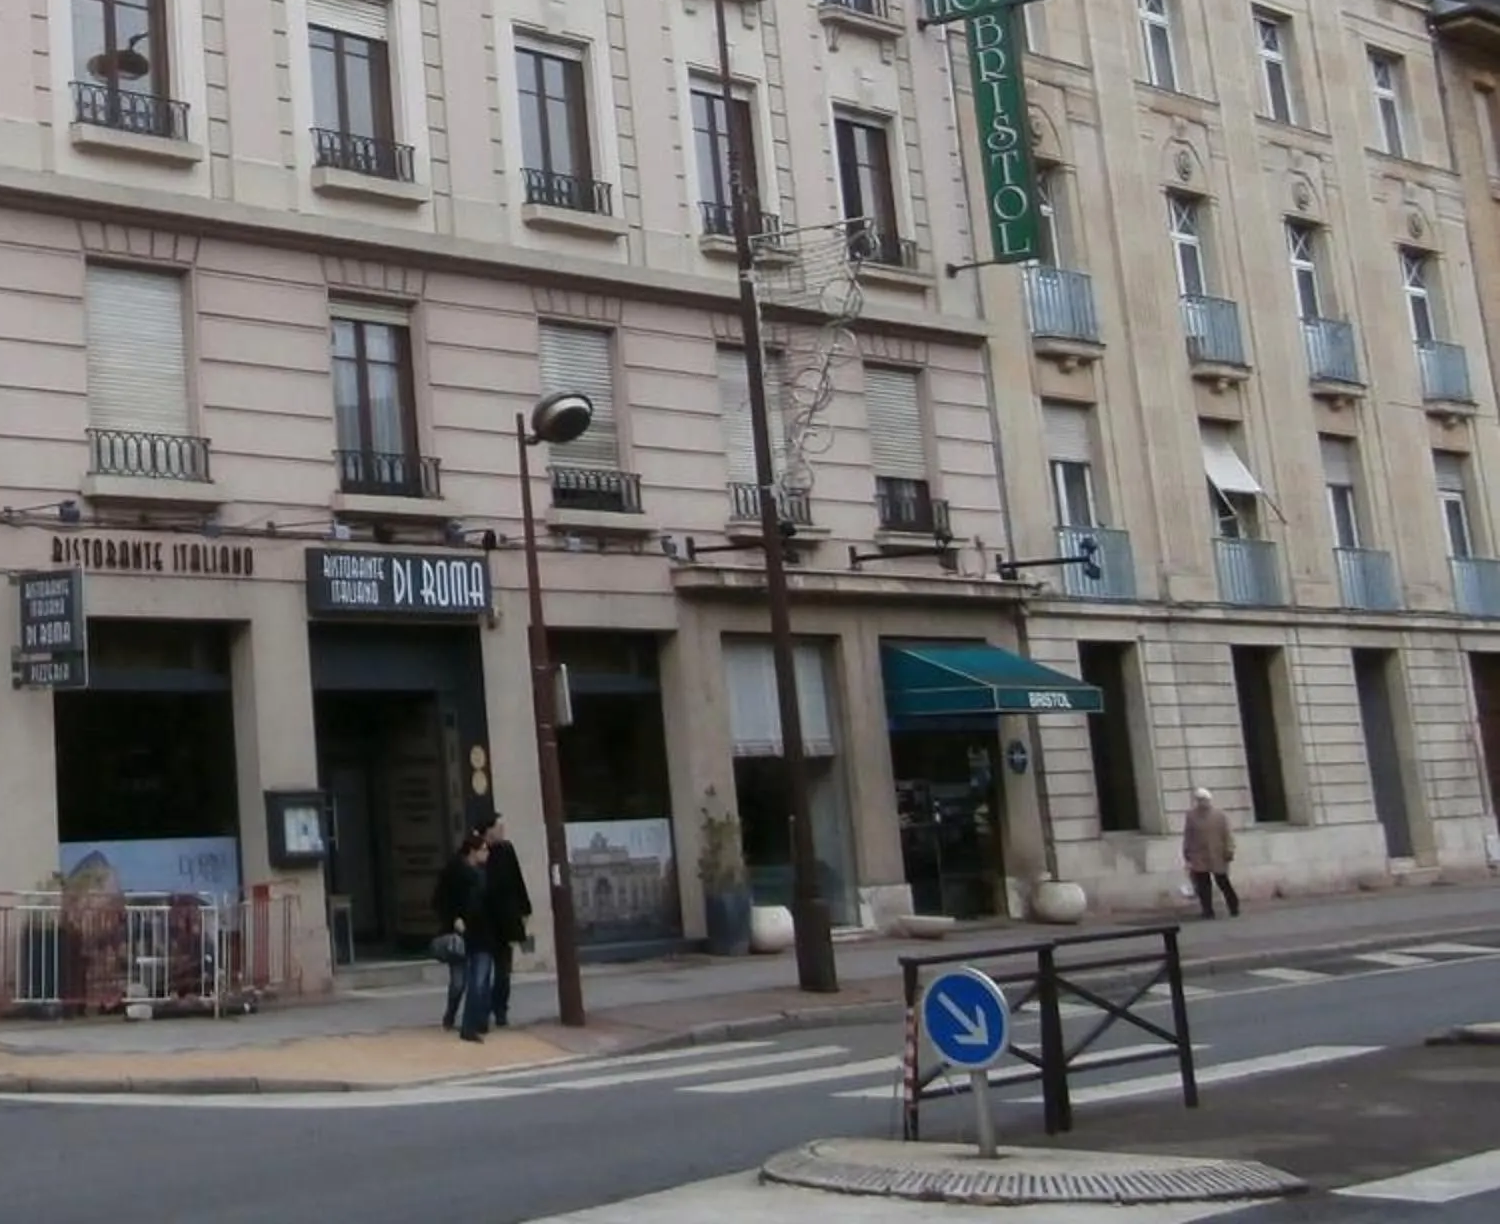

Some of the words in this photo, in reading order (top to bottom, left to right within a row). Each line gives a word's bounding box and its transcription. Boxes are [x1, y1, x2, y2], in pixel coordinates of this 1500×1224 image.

[973, 15, 1031, 255] BRISTOL
[51, 535, 164, 572] RISTORANTE
[172, 542, 255, 577] ITALIANO
[323, 554, 384, 580] RISTORANTE
[331, 580, 379, 604] ITALIANO
[392, 557, 414, 606] DI
[420, 559, 486, 608] ROMA
[25, 624, 37, 647] DI
[40, 620, 72, 647] ROMA
[1028, 691, 1072, 708] BRISTOL
